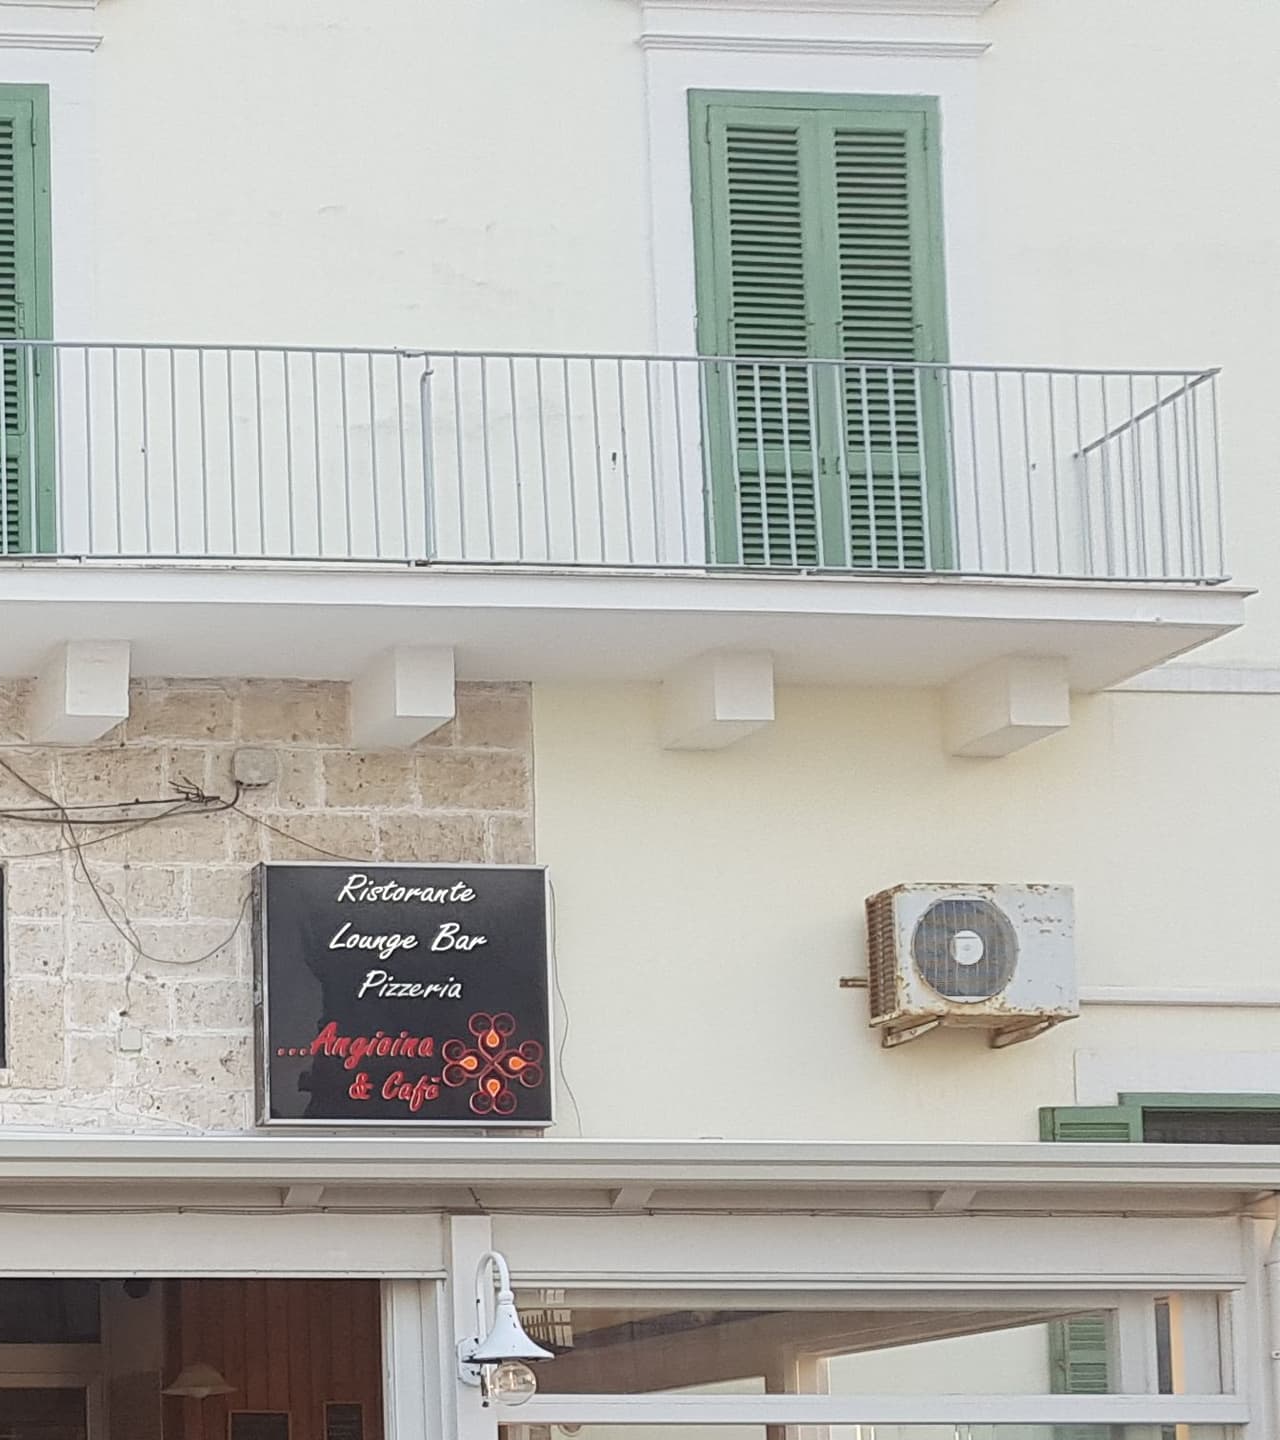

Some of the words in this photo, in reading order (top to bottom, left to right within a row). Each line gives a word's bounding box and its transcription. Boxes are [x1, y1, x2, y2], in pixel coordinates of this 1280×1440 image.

[338, 874, 476, 904] Ristorante
[329, 922, 418, 960] Lounge
[431, 922, 487, 951] Bar
[358, 970, 462, 999] Pizzeria
[348, 1072, 373, 1099] &
